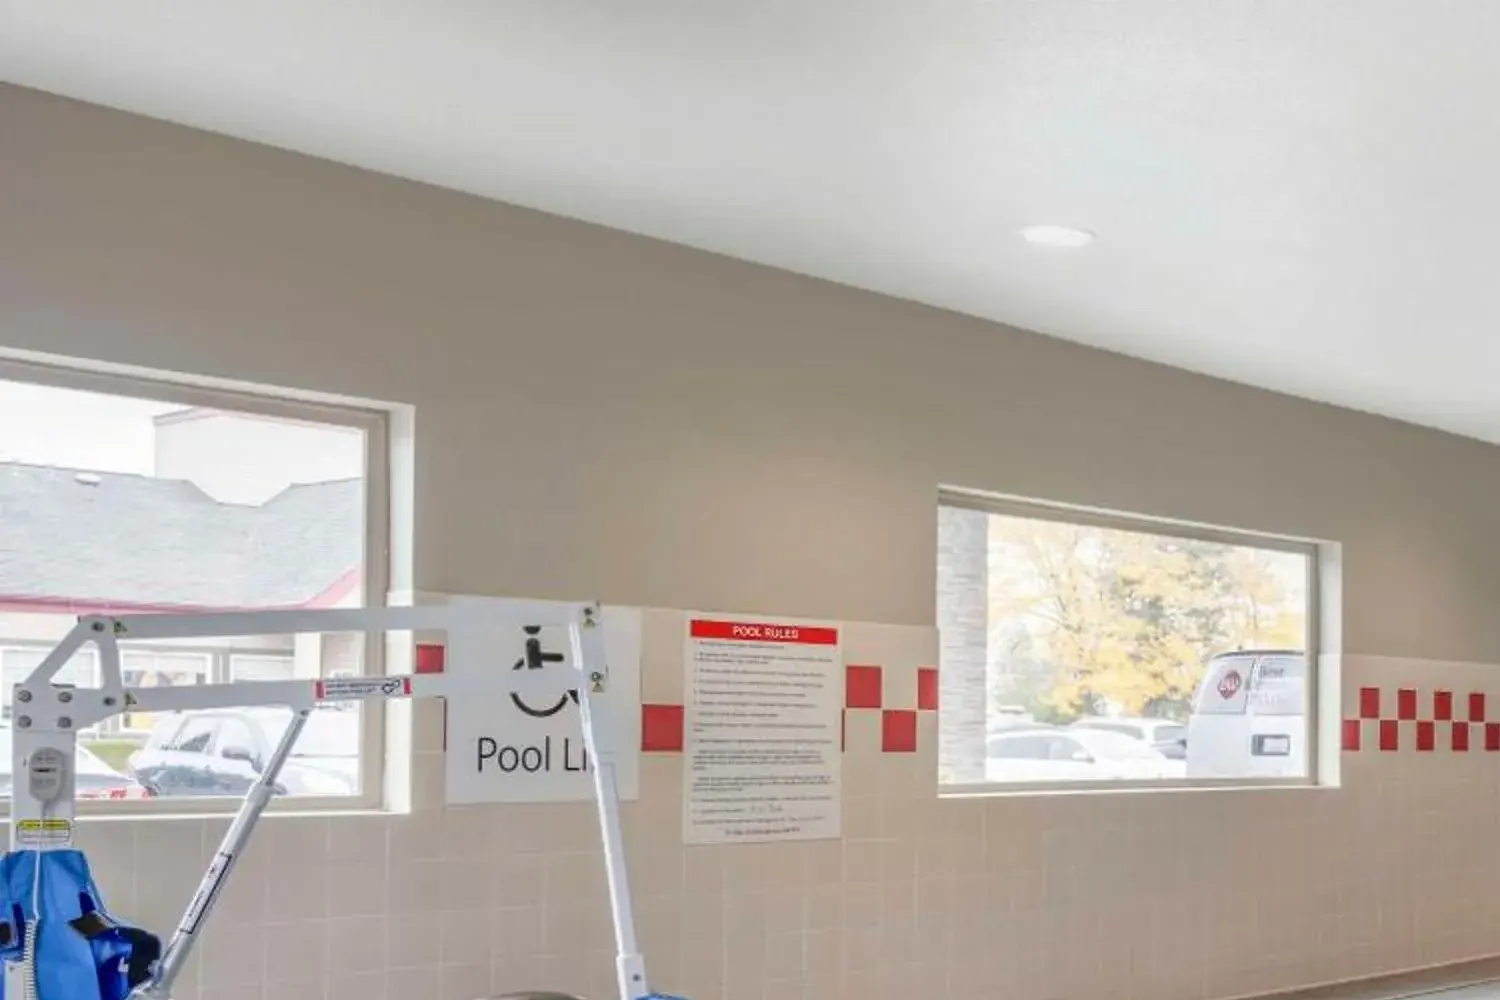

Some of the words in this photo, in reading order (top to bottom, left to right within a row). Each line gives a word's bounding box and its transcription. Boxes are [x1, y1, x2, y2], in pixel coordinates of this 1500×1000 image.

[732, 625, 762, 637] POOL
[765, 627, 799, 639] RULES
[477, 735, 551, 773] Pool
[564, 737, 588, 772] Li
